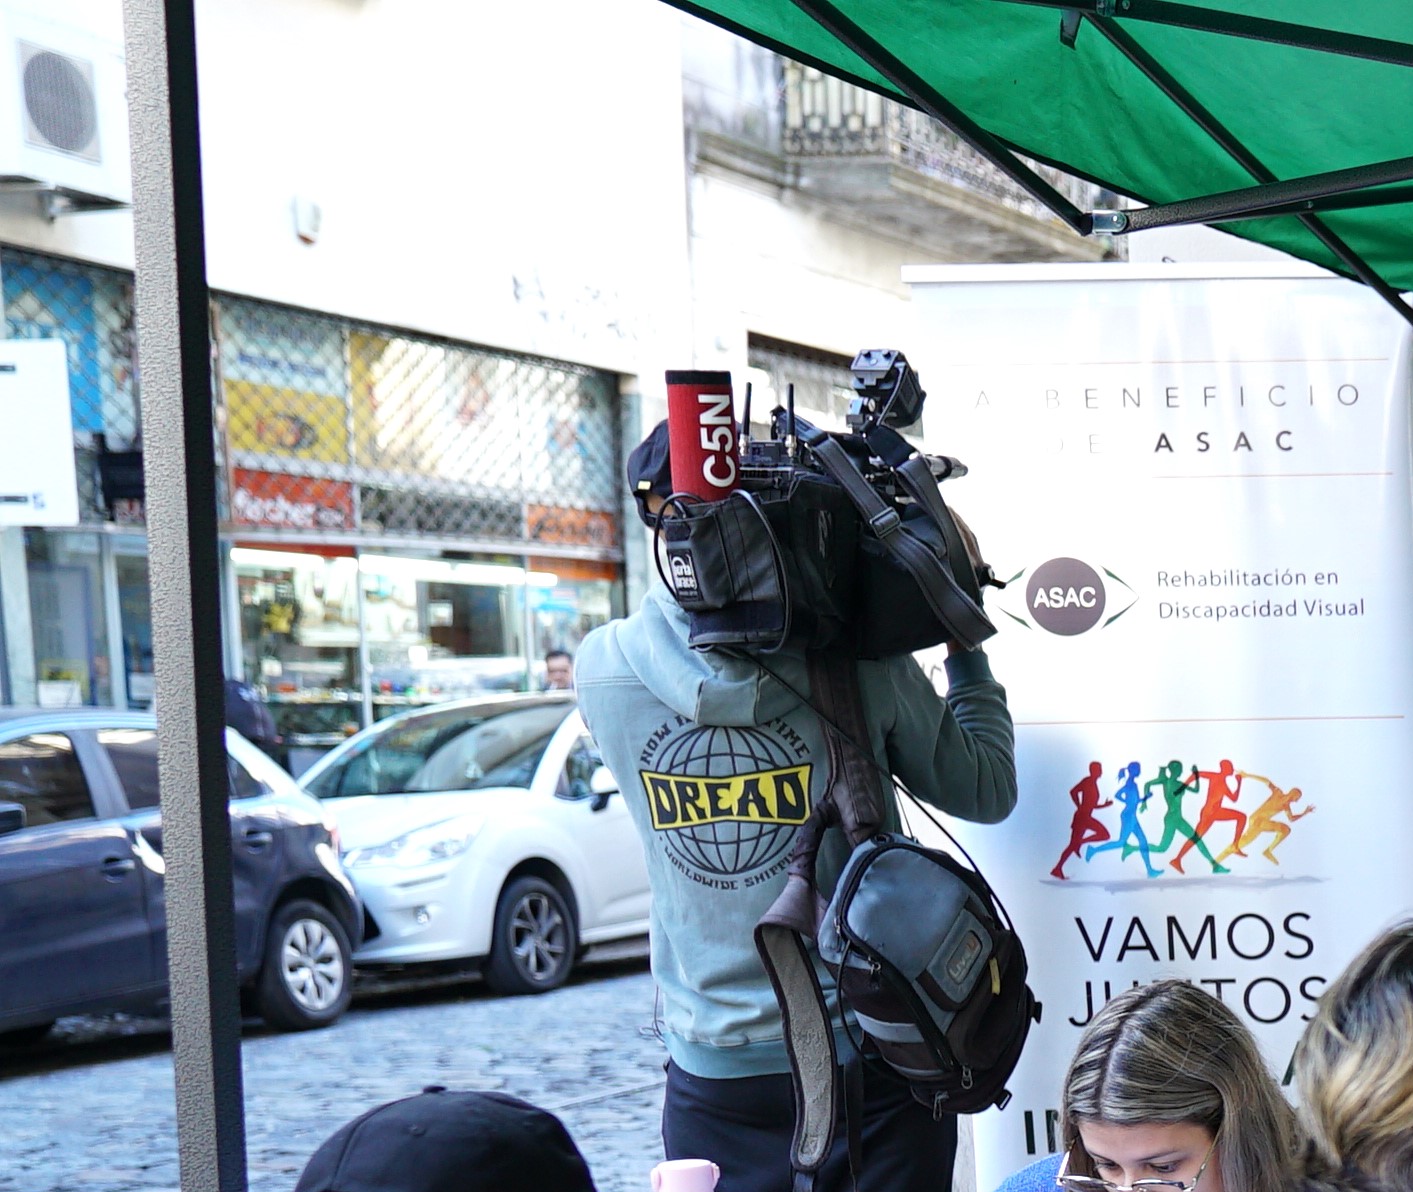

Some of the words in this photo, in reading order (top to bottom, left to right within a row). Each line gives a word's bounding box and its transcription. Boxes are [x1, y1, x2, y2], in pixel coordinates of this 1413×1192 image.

[974, 389, 991, 409] A
[1045, 383, 1359, 409] BENEFICIO
[697, 393, 736, 488] C5N
[1154, 430, 1294, 453] ASAC
[1033, 586, 1097, 609] ASAC
[1156, 568, 1307, 588] Rehabilitación
[1314, 571, 1339, 586] en
[1159, 599, 1298, 622] Discapacidad
[1303, 598, 1365, 617] Visual
[640, 722, 672, 766] NOW
[650, 772, 805, 825] DREAD
[664, 845, 739, 891] WORLDWIDE
[744, 848, 795, 888] SHIPPI
[1074, 912, 1315, 963] VAMOS
[1068, 975, 1328, 1027] JTOS
